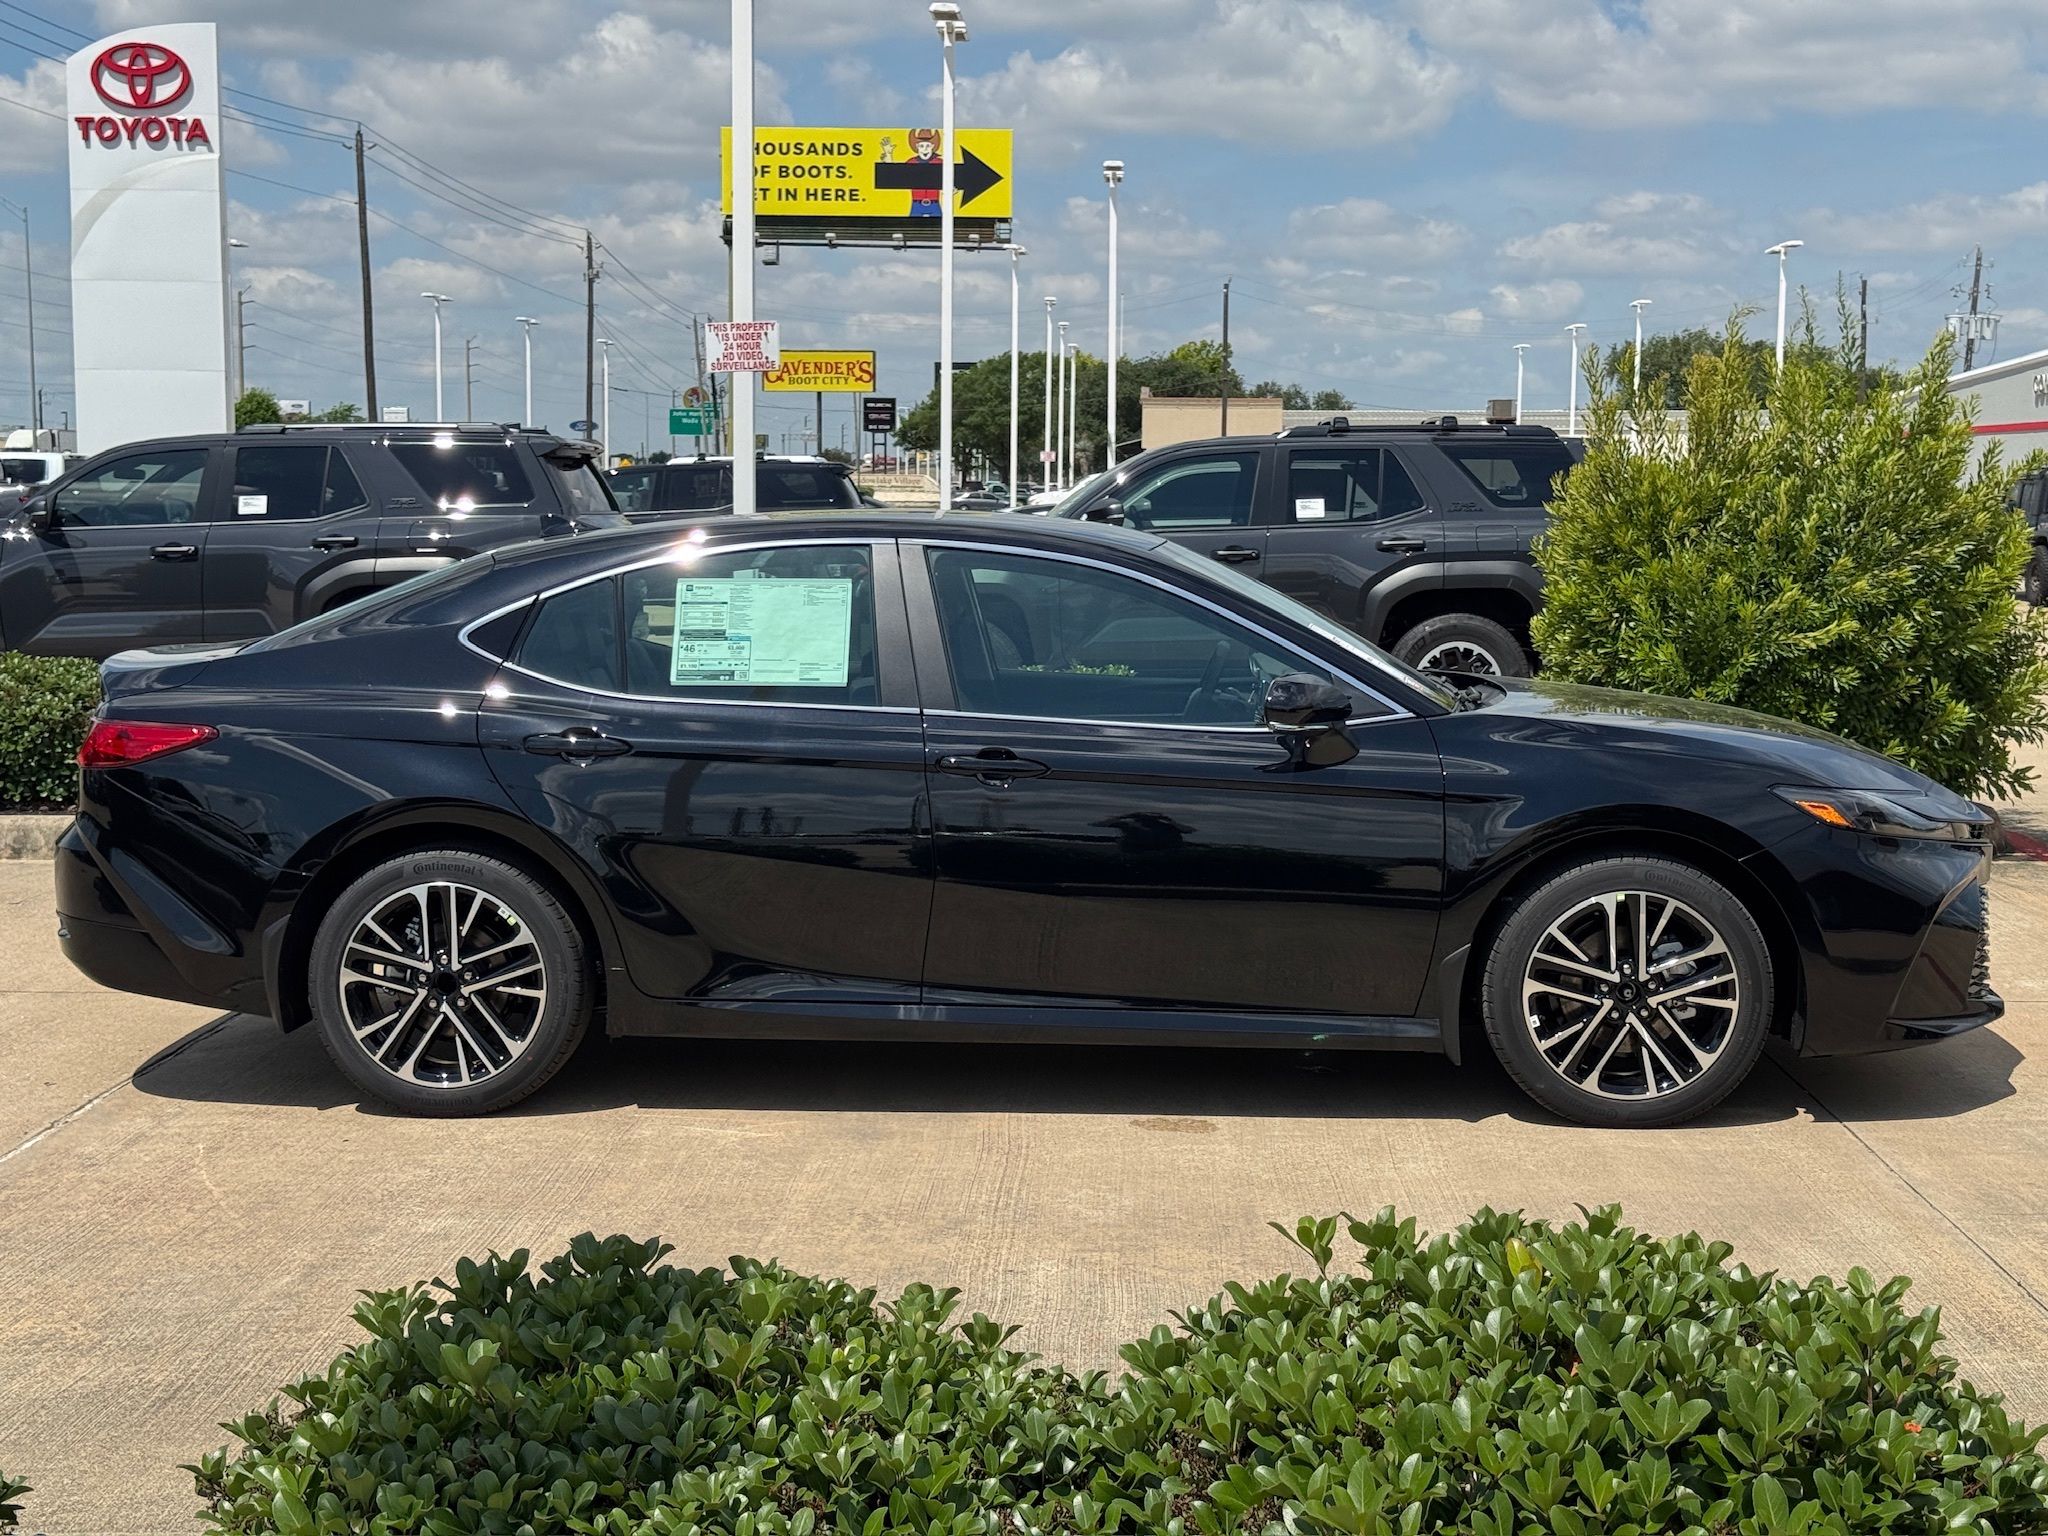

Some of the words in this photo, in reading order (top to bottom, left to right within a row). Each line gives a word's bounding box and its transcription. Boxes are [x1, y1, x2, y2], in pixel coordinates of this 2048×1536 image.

[74, 116, 209, 142] TOYOTA
[754, 142, 863, 156] HOUSANDS
[778, 165, 853, 179] BOOTS.
[777, 188, 798, 201] IN
[805, 188, 867, 202] HERE.
[707, 324, 728, 333] THIS
[730, 322, 776, 332] PROPERTY
[721, 333, 730, 342] IS
[732, 332, 763, 341] UNDER
[723, 342, 734, 351] 24
[736, 341, 762, 350] HOUR
[722, 352, 735, 361] HD
[736, 351, 763, 361] VIDEO
[711, 361, 776, 371] SURVEILLANCE
[788, 376, 819, 385] BOOT
[822, 376, 850, 385] CITY
[683, 644, 696, 653] 46
[413, 861, 476, 876] Continental
[1645, 869, 1708, 898] Continental
